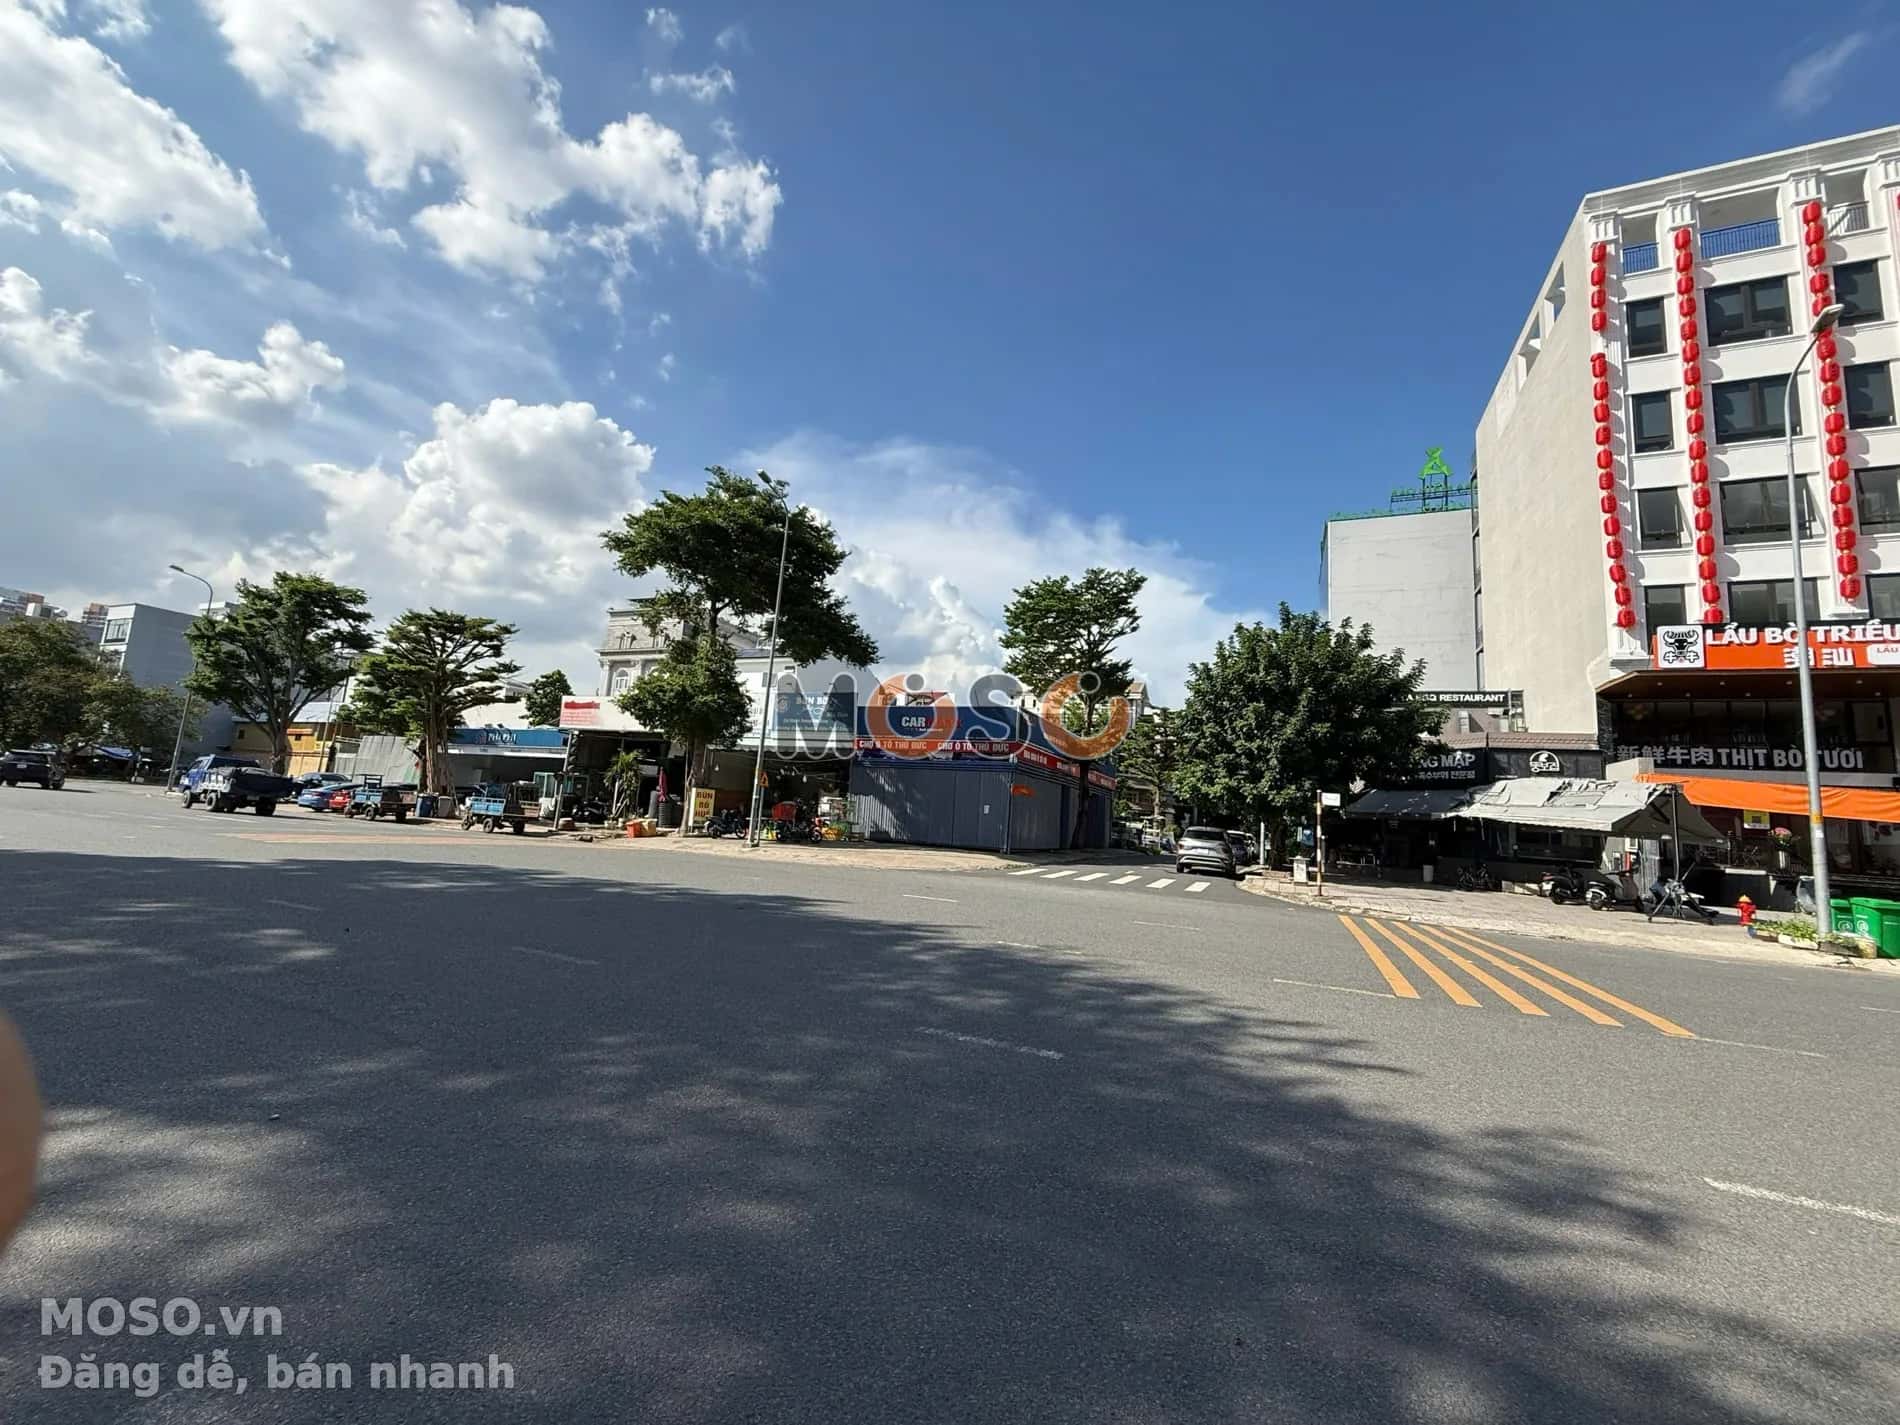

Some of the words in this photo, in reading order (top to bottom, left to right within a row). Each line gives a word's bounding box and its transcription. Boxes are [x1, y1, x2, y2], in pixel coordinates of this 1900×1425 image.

[1764, 621, 1799, 644] BÒ
[1440, 693, 1505, 703] RESTAURANT
[901, 715, 926, 728] CAR
[1616, 745, 1714, 765] 新鮮牛肉
[1717, 749, 1767, 770] THỊT
[1772, 744, 1803, 768] BÒ
[1816, 747, 1863, 769] ƯƠI
